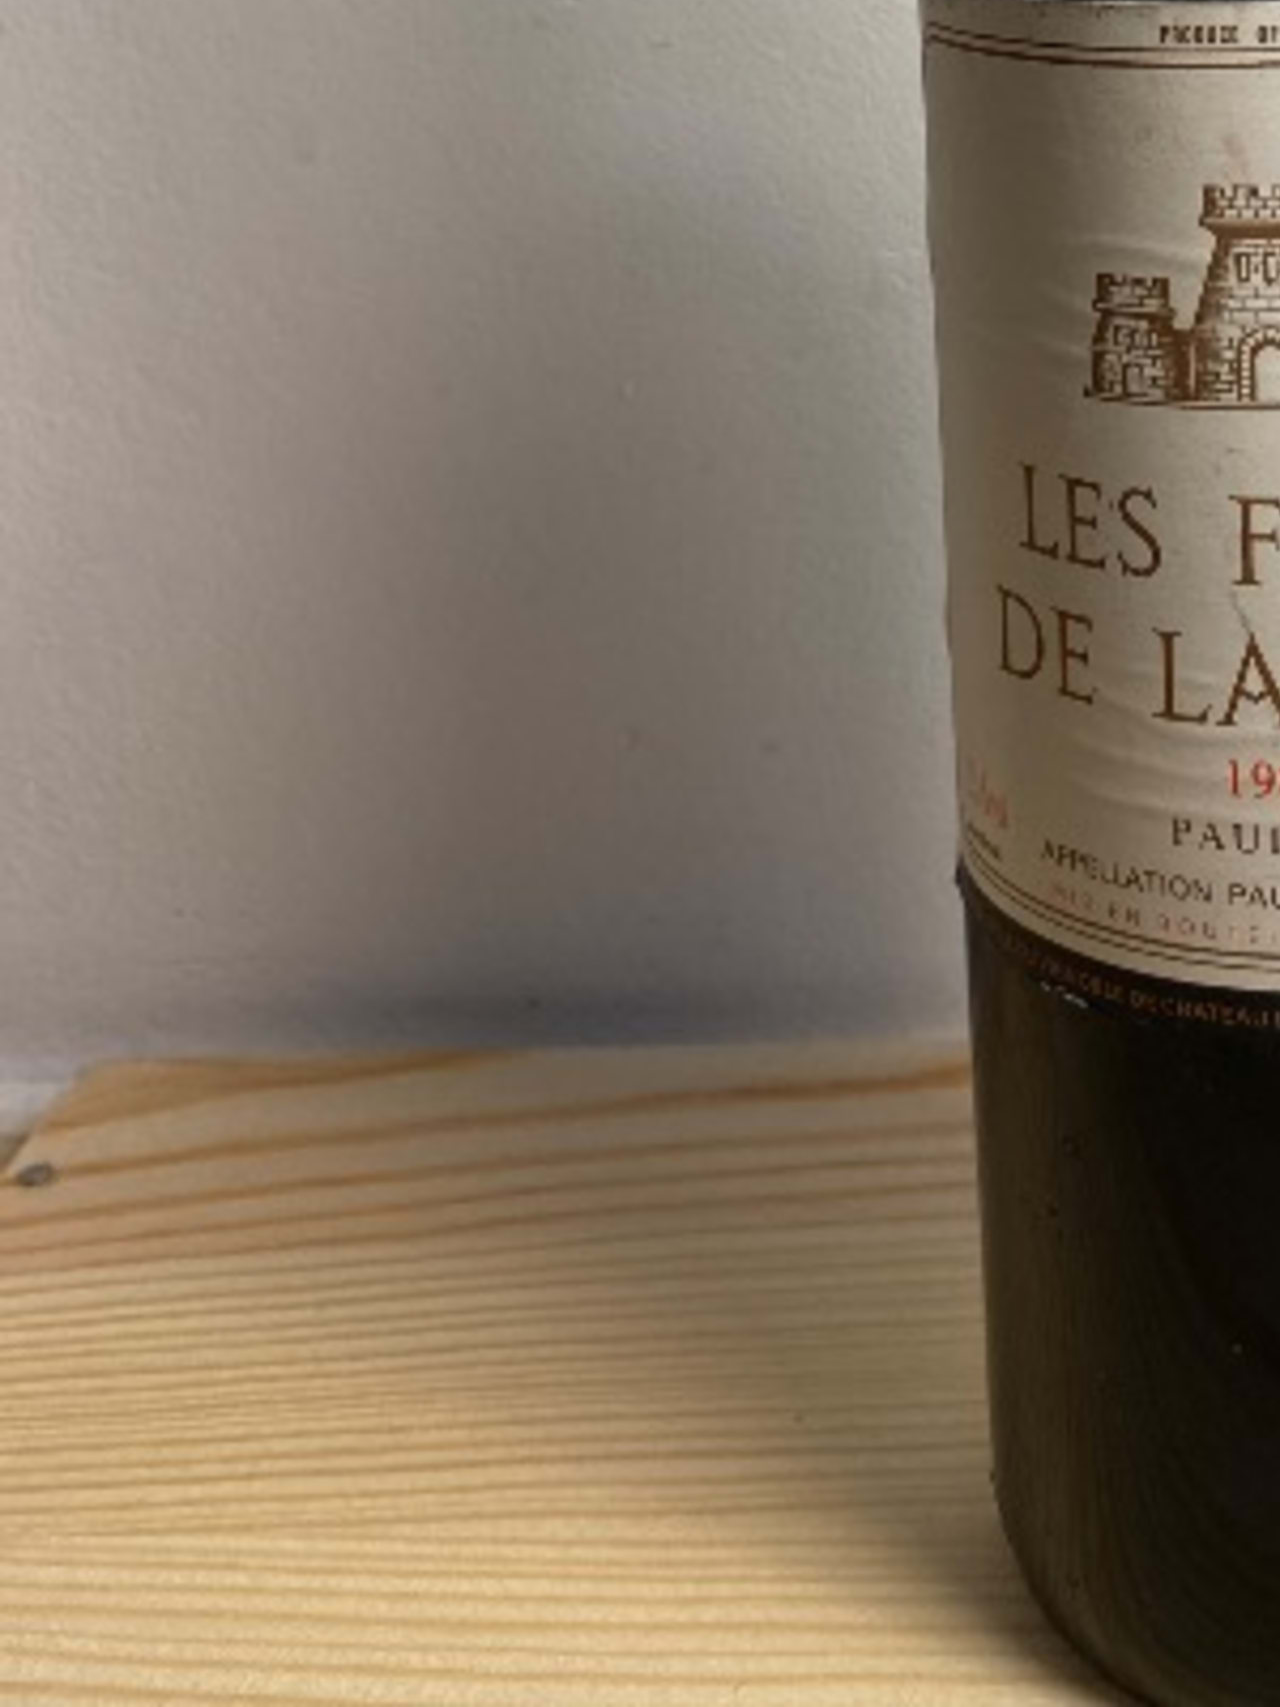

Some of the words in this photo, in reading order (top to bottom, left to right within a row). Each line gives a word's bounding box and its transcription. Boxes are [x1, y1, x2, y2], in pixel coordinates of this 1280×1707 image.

[1019, 463, 1162, 578] LES
[996, 585, 1095, 705] DE
[1040, 838, 1213, 904] APPELLATION
